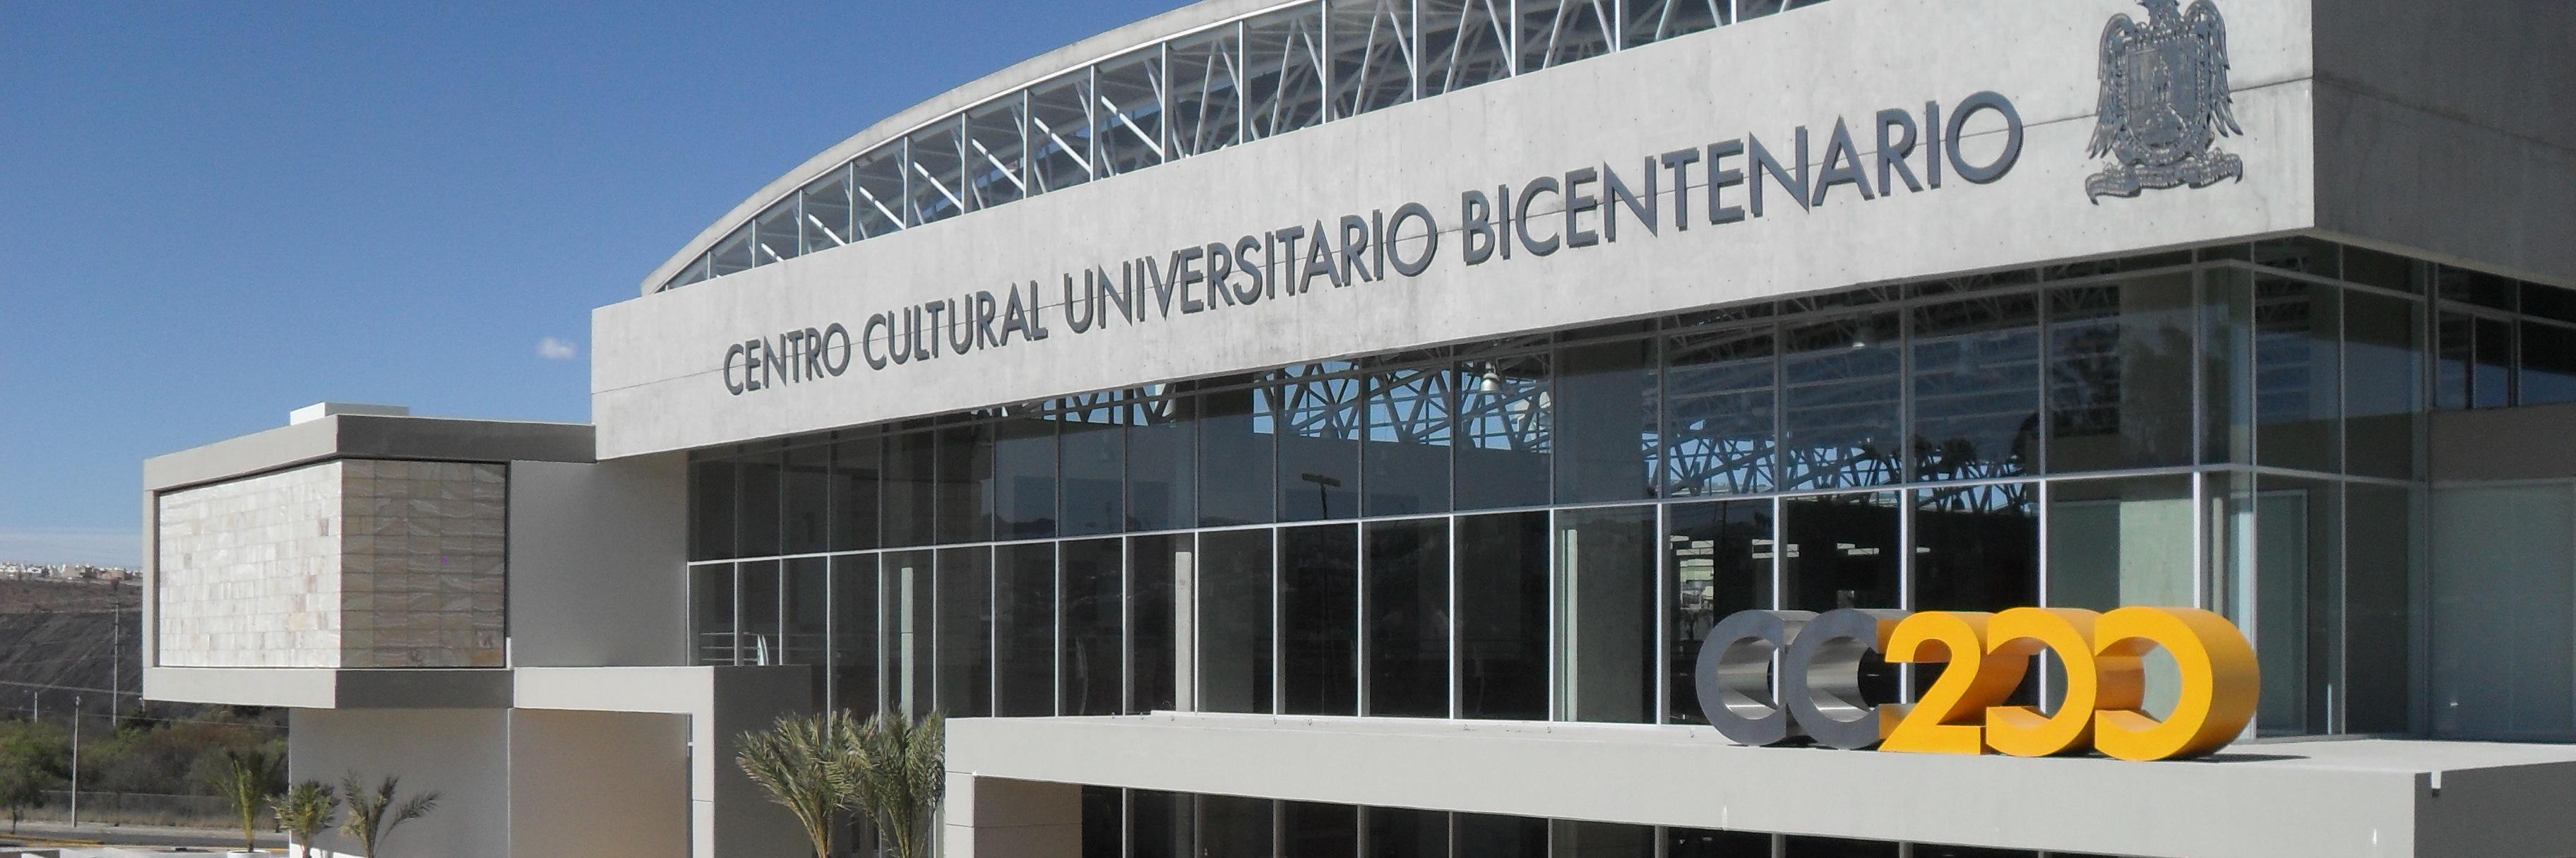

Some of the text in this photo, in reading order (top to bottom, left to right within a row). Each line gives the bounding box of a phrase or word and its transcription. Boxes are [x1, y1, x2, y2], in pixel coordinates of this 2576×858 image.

[723, 90, 2024, 395] CENTRO CULTURAL UNIVERSITARIO BICENTENARIO
